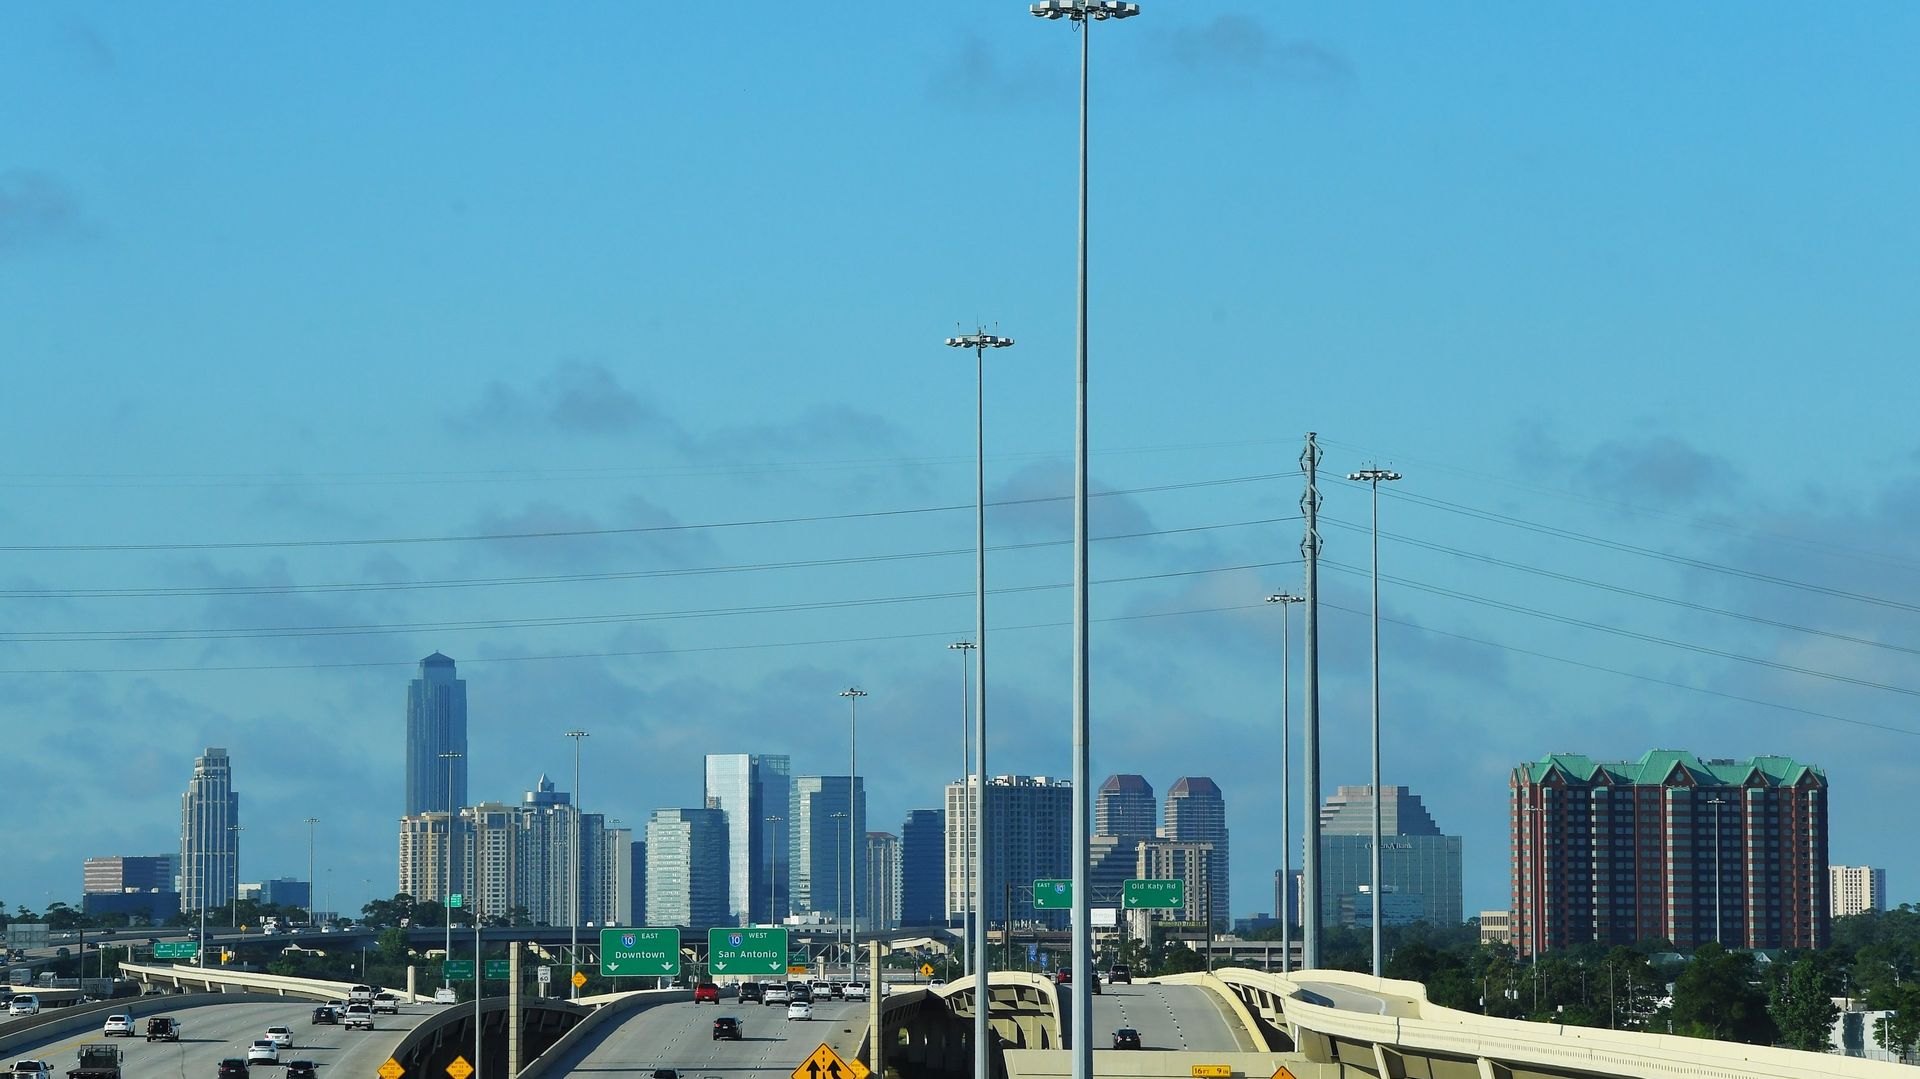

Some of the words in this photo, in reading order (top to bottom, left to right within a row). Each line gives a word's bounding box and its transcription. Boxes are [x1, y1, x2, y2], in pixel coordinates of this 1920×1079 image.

[1147, 883, 1163, 891] Katy
[624, 937, 633, 945] 10
[731, 936, 740, 945] 10
[615, 951, 665, 959] Downtown
[718, 950, 736, 958] San
[740, 949, 778, 958] Antonio
